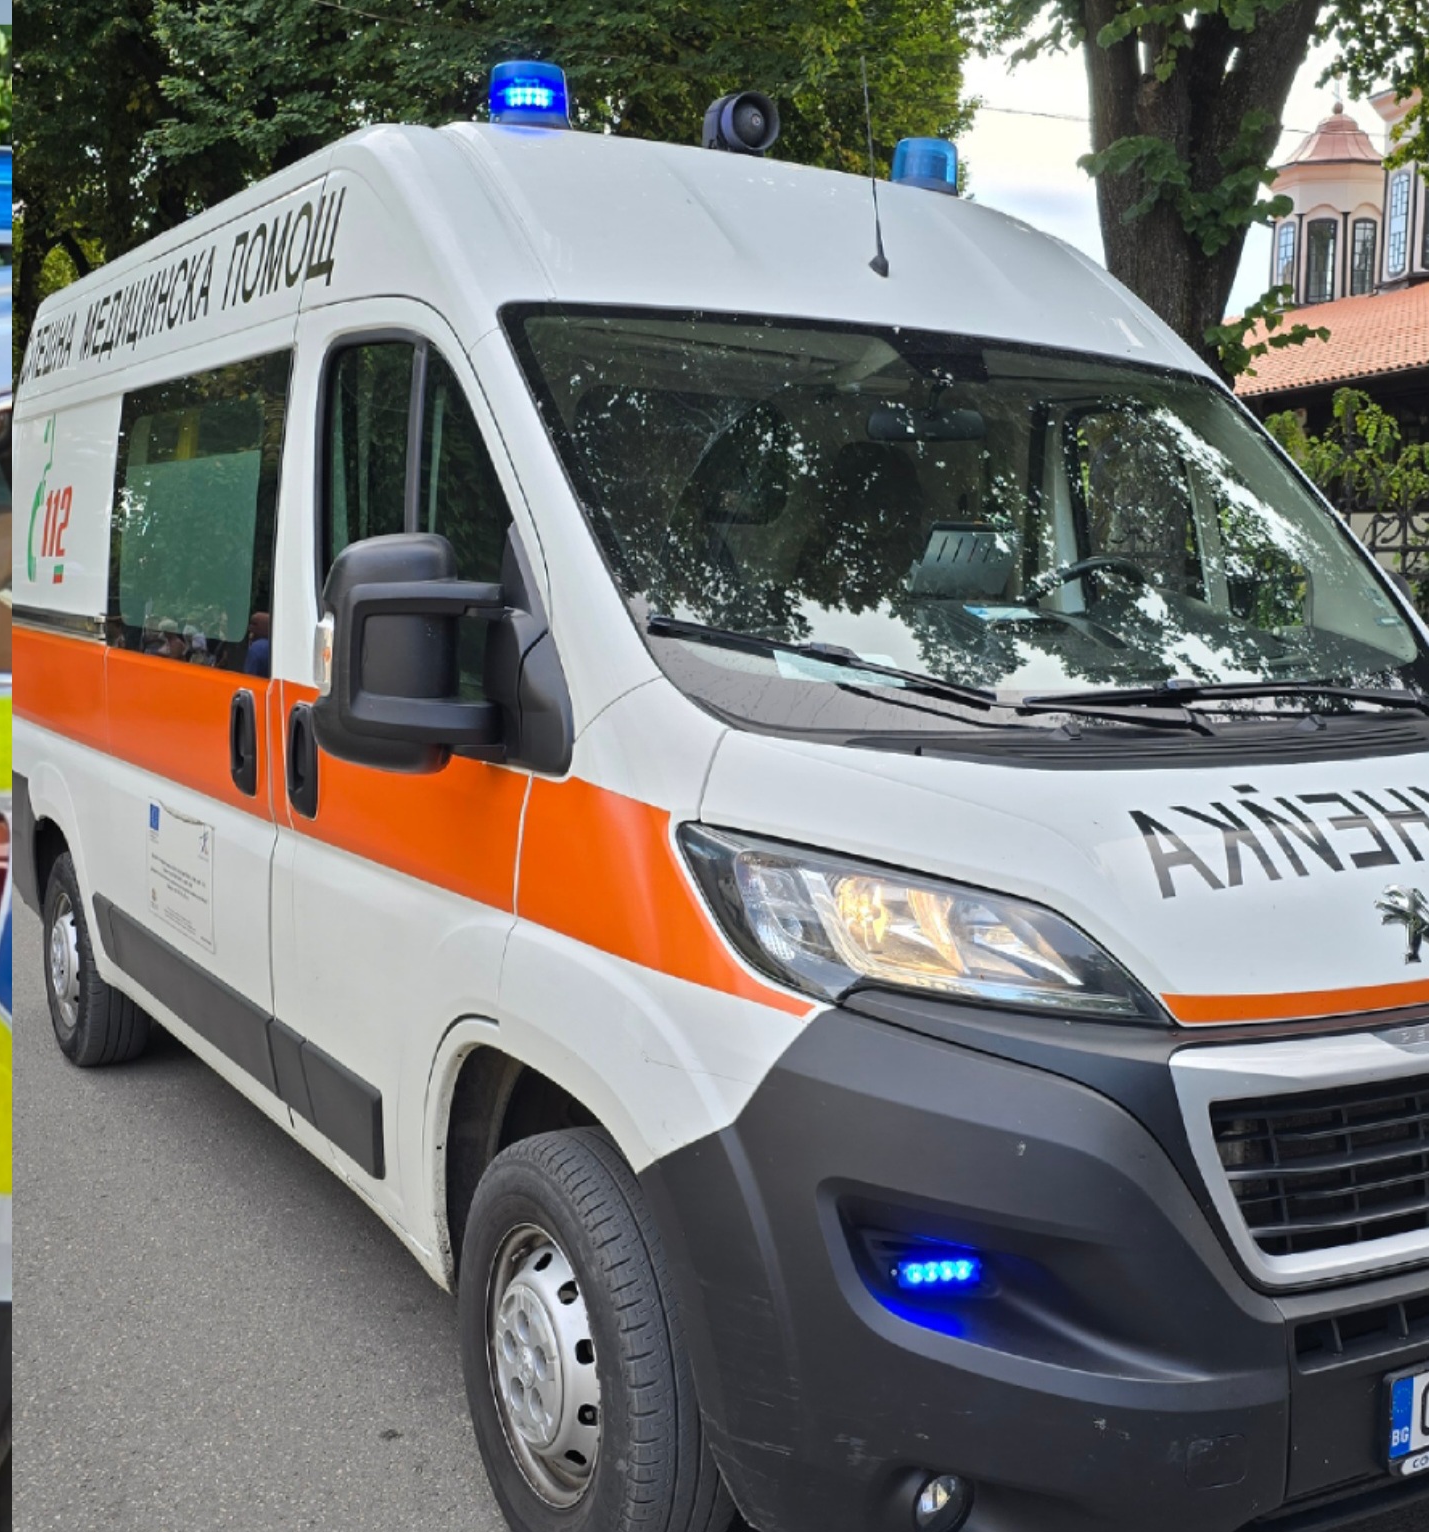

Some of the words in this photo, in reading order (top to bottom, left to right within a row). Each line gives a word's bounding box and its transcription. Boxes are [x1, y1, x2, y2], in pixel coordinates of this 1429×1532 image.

[79, 246, 216, 363] МЕДИЦИНСКА
[221, 186, 347, 311] ПОМОЩ
[41, 485, 72, 557] 112
[1391, 1426, 1410, 1447] BG
